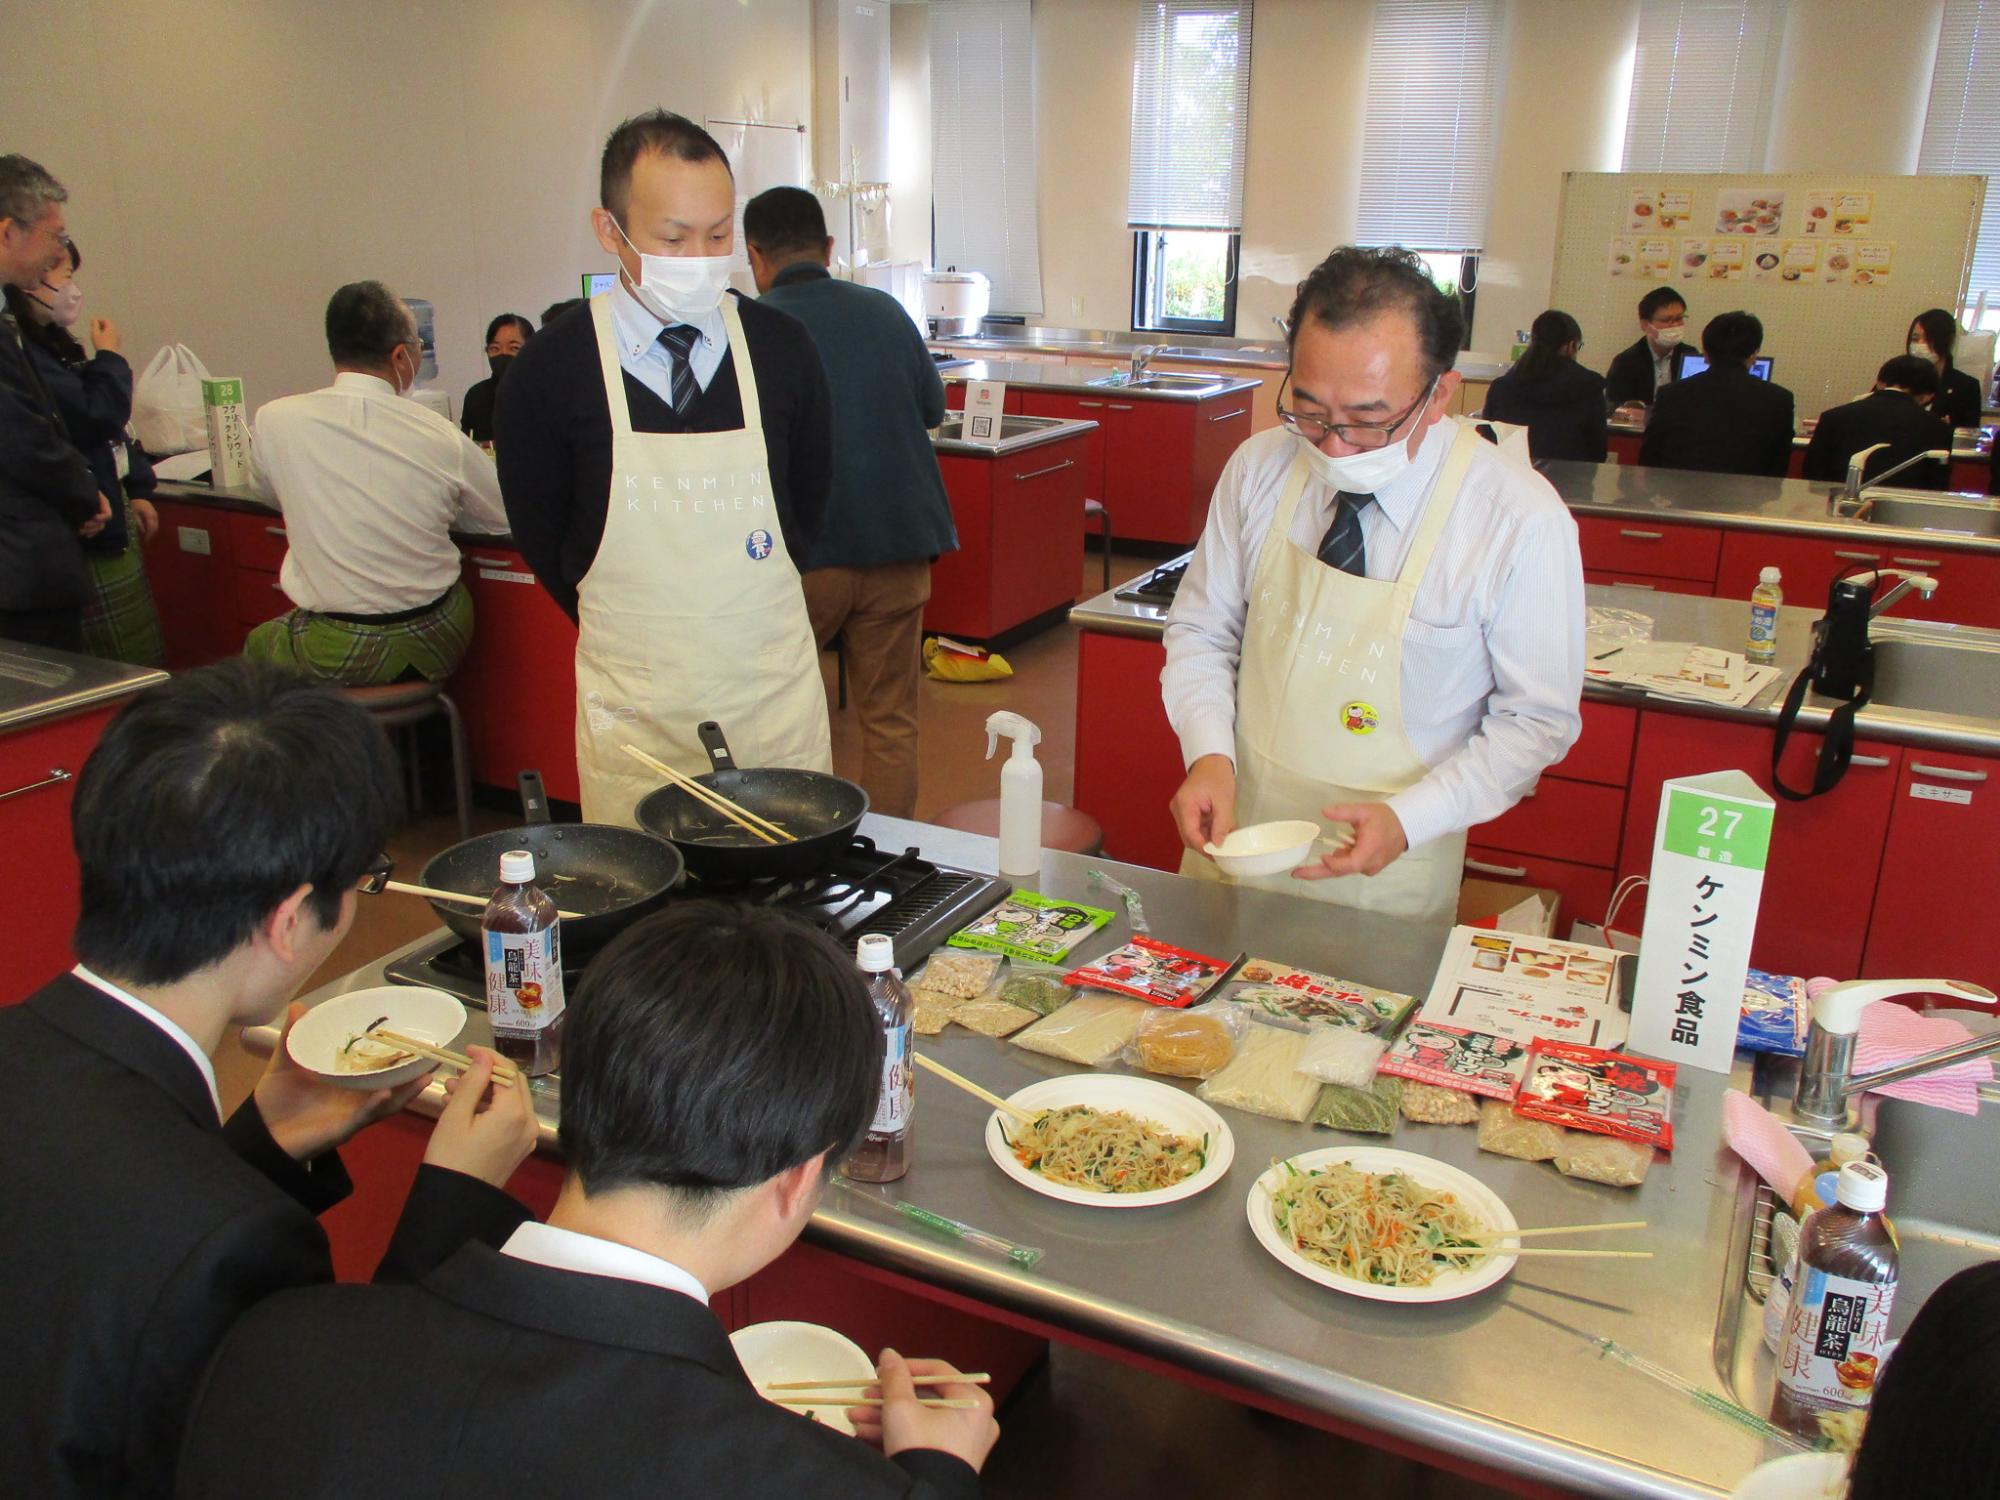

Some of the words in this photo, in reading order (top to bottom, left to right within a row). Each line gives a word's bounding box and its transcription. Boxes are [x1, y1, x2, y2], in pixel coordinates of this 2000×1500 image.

[221, 385, 233, 396] 28
[626, 471, 761, 490] KENMIN
[628, 495, 764, 513] KITCHEN
[1261, 589, 1385, 659] KENMIN
[1917, 785, 1966, 800] ミキサー
[1697, 806, 1743, 840] 27
[1696, 845, 1734, 863] 製造
[523, 939, 542, 983] 美味
[1671, 875, 1724, 1047] ケンミン食品
[489, 972, 508, 1016] 健康
[1854, 1284, 1896, 1351] 美味
[1783, 1306, 1818, 1379] 健康
